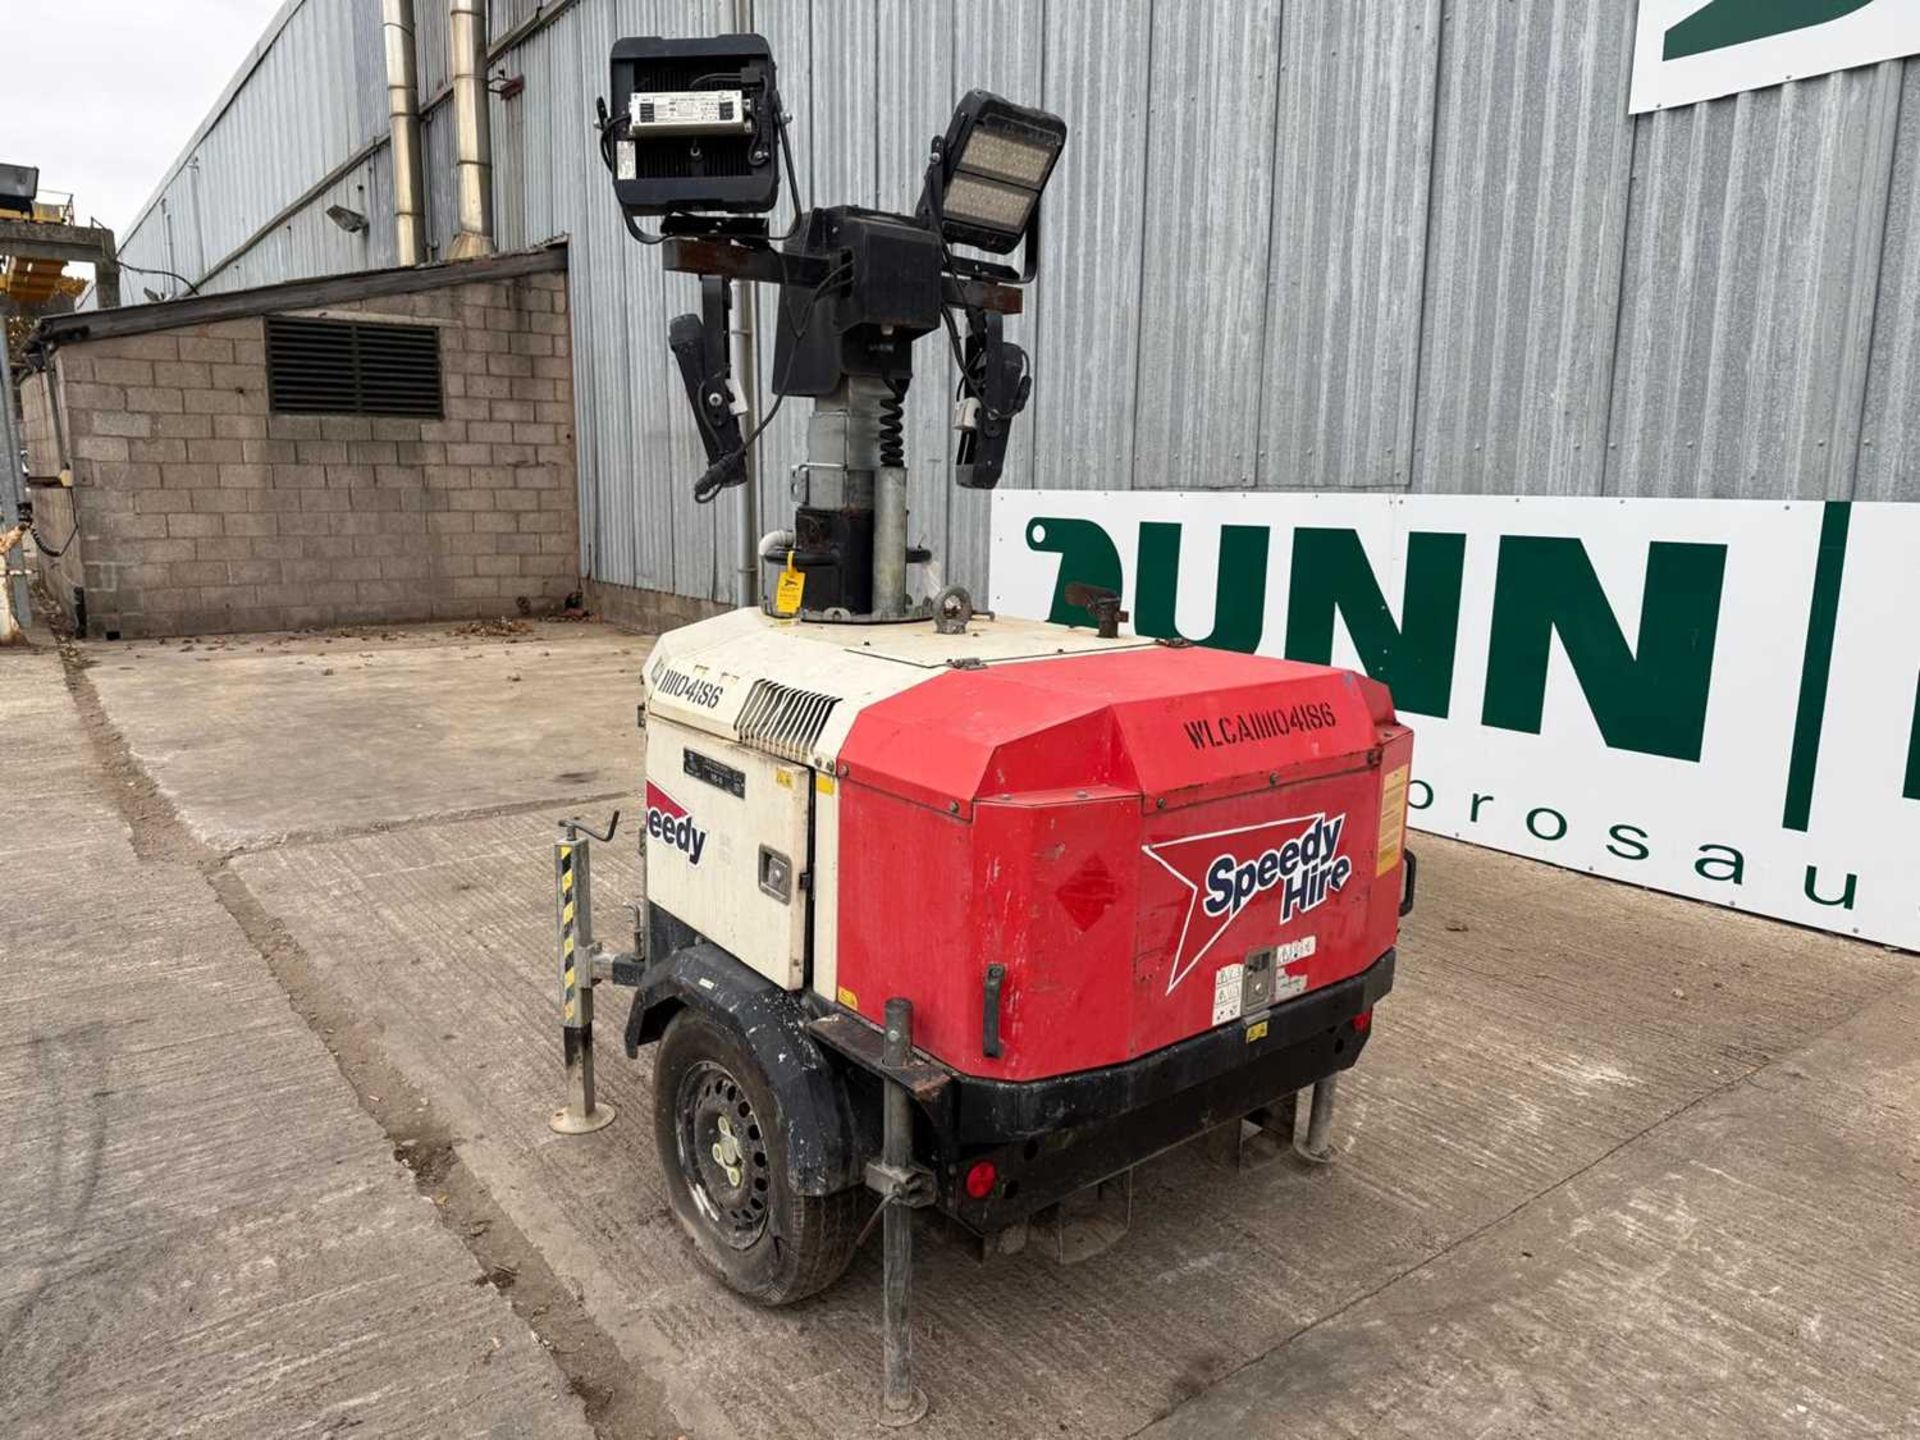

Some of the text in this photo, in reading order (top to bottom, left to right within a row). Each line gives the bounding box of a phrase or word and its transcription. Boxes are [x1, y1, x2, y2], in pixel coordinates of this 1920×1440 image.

[1026, 516, 1728, 763] DUNN
[646, 808, 707, 867] eedy
[1204, 815, 1344, 915] Speedy
[1281, 857, 1351, 923] Hire
